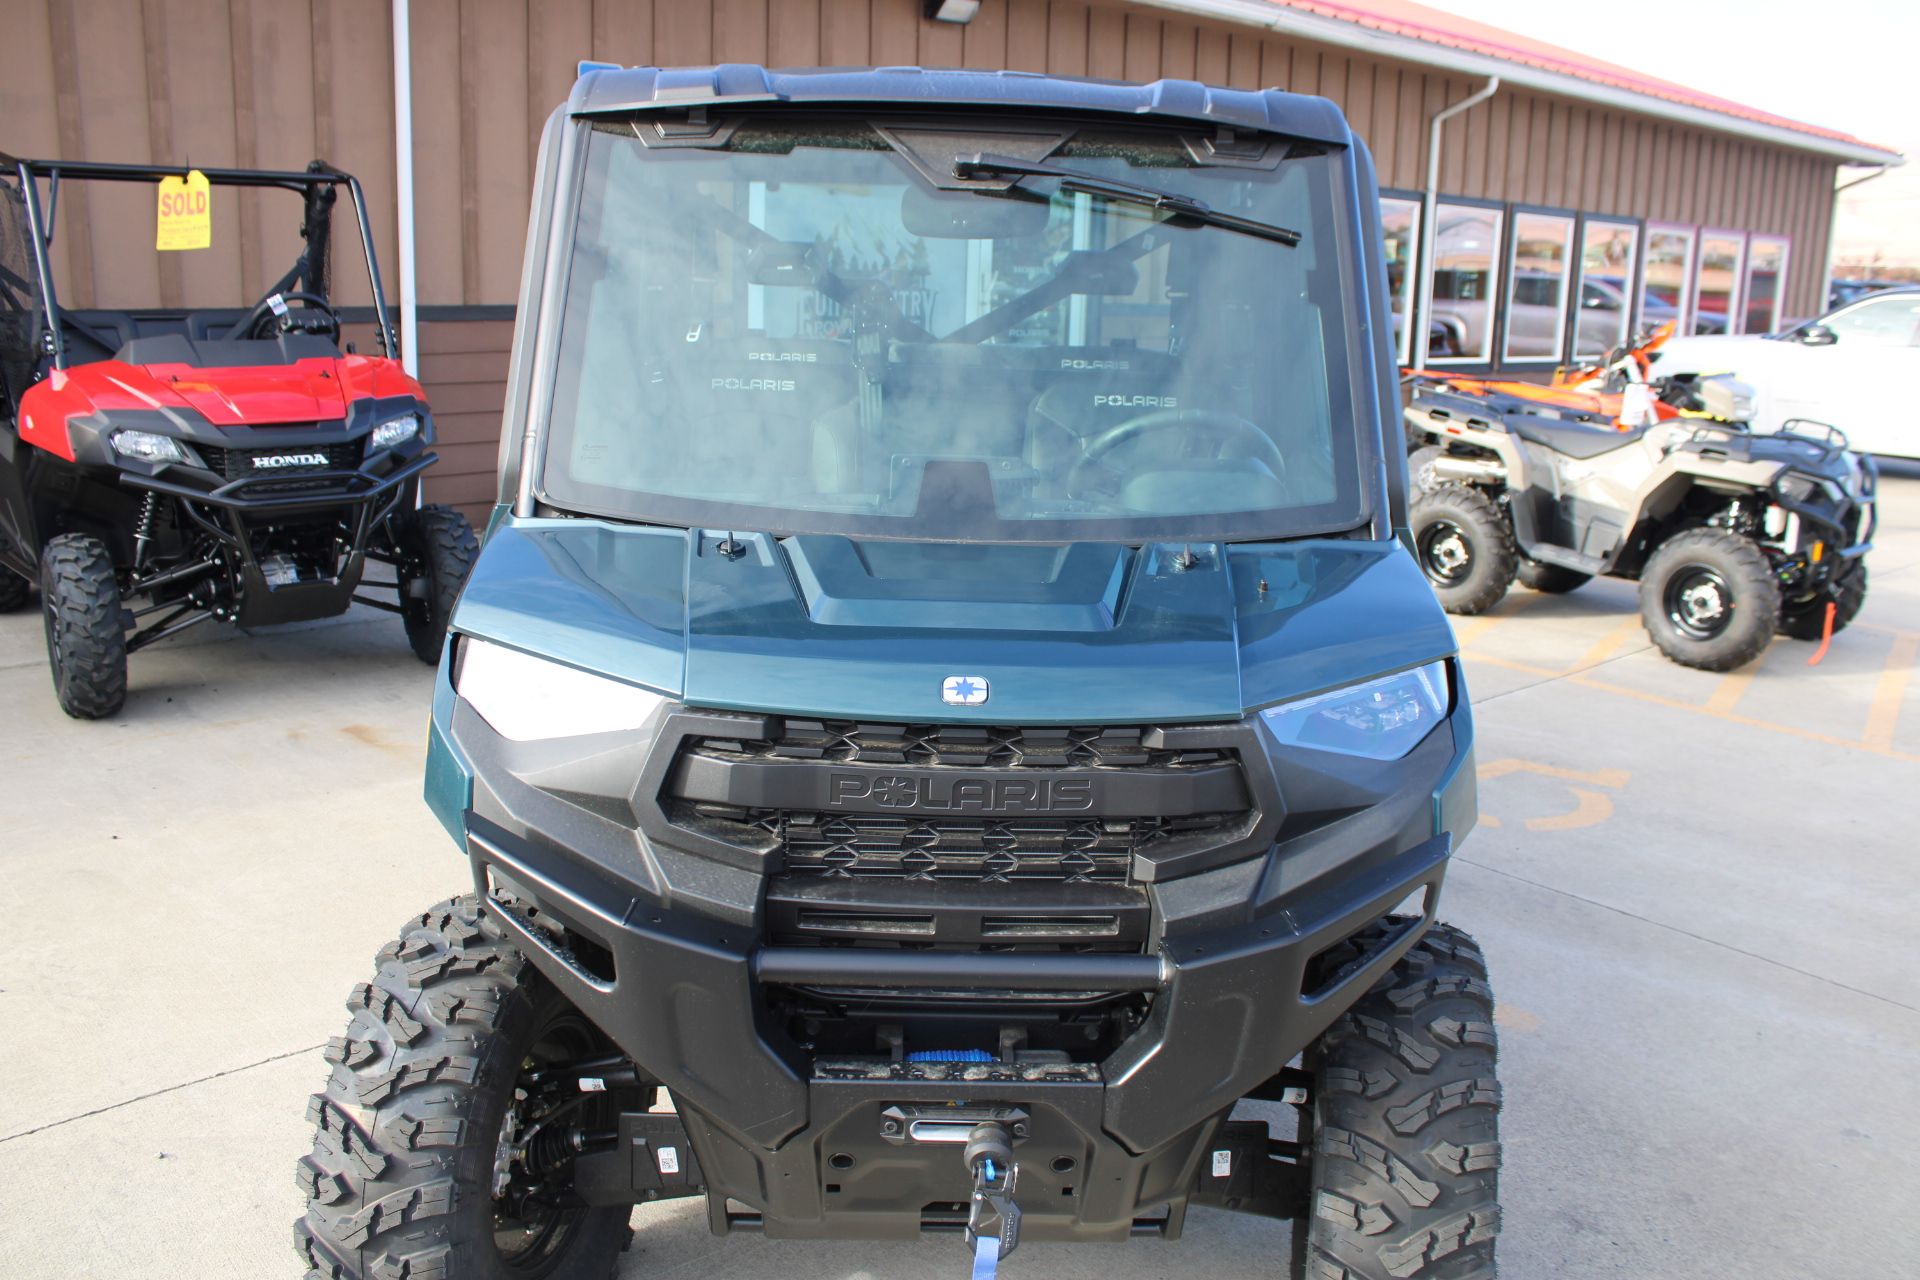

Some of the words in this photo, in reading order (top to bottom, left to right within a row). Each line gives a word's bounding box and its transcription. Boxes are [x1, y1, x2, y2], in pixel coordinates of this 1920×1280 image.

[161, 191, 206, 217] SOLD
[748, 352, 817, 362] POLARIS
[1061, 359, 1129, 370] POLARIS
[711, 378, 795, 391] POLARIS
[1094, 395, 1177, 408] POLARIS
[252, 453, 329, 468] HONDA
[830, 773, 1093, 811] POLARIS
